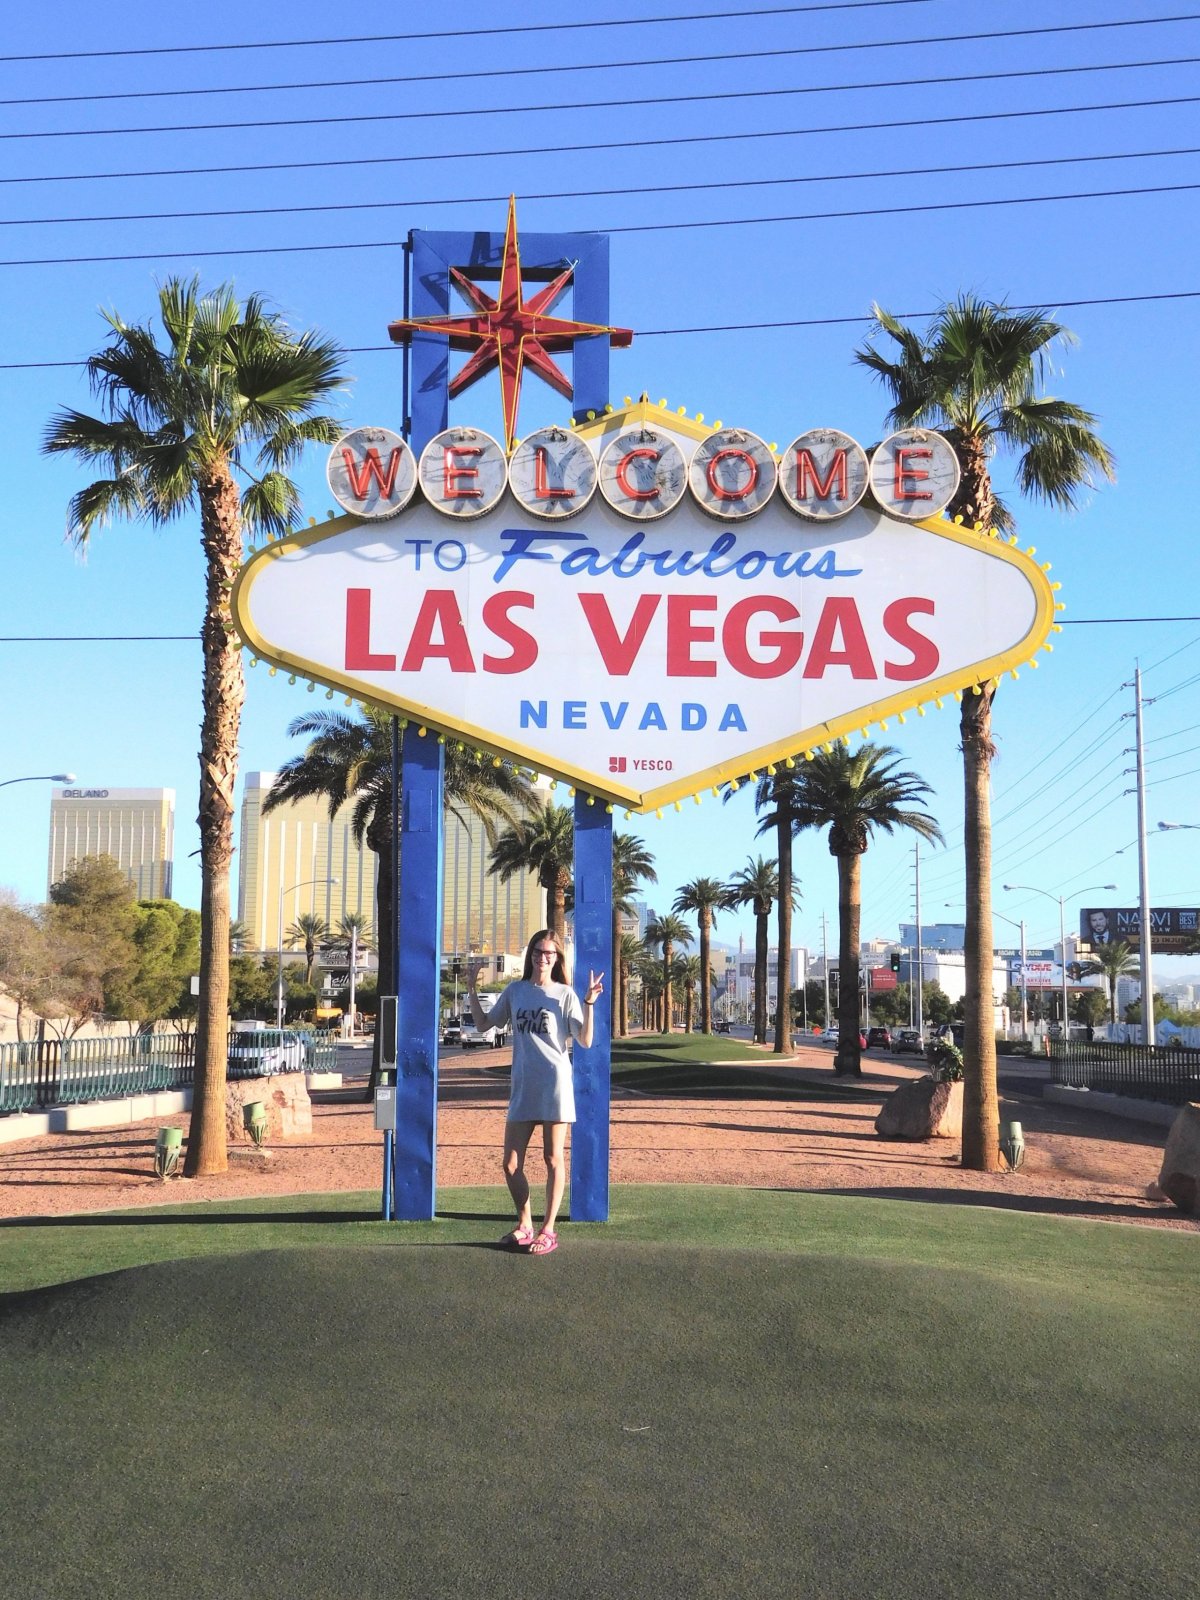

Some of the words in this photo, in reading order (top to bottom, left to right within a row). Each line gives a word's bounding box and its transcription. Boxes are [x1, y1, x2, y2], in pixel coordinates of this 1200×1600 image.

[342, 447, 934, 501] WELCOME
[404, 539, 468, 572] TO
[493, 529, 863, 583] Fabulous
[344, 587, 539, 675] LAS
[577, 592, 940, 681] VEGAS
[519, 700, 748, 732] NEVADA
[633, 759, 673, 771] YESCO
[62, 789, 109, 798] DELANO
[1179, 916, 1196, 925] BEST
[1013, 963, 1053, 972] SYDIVE
